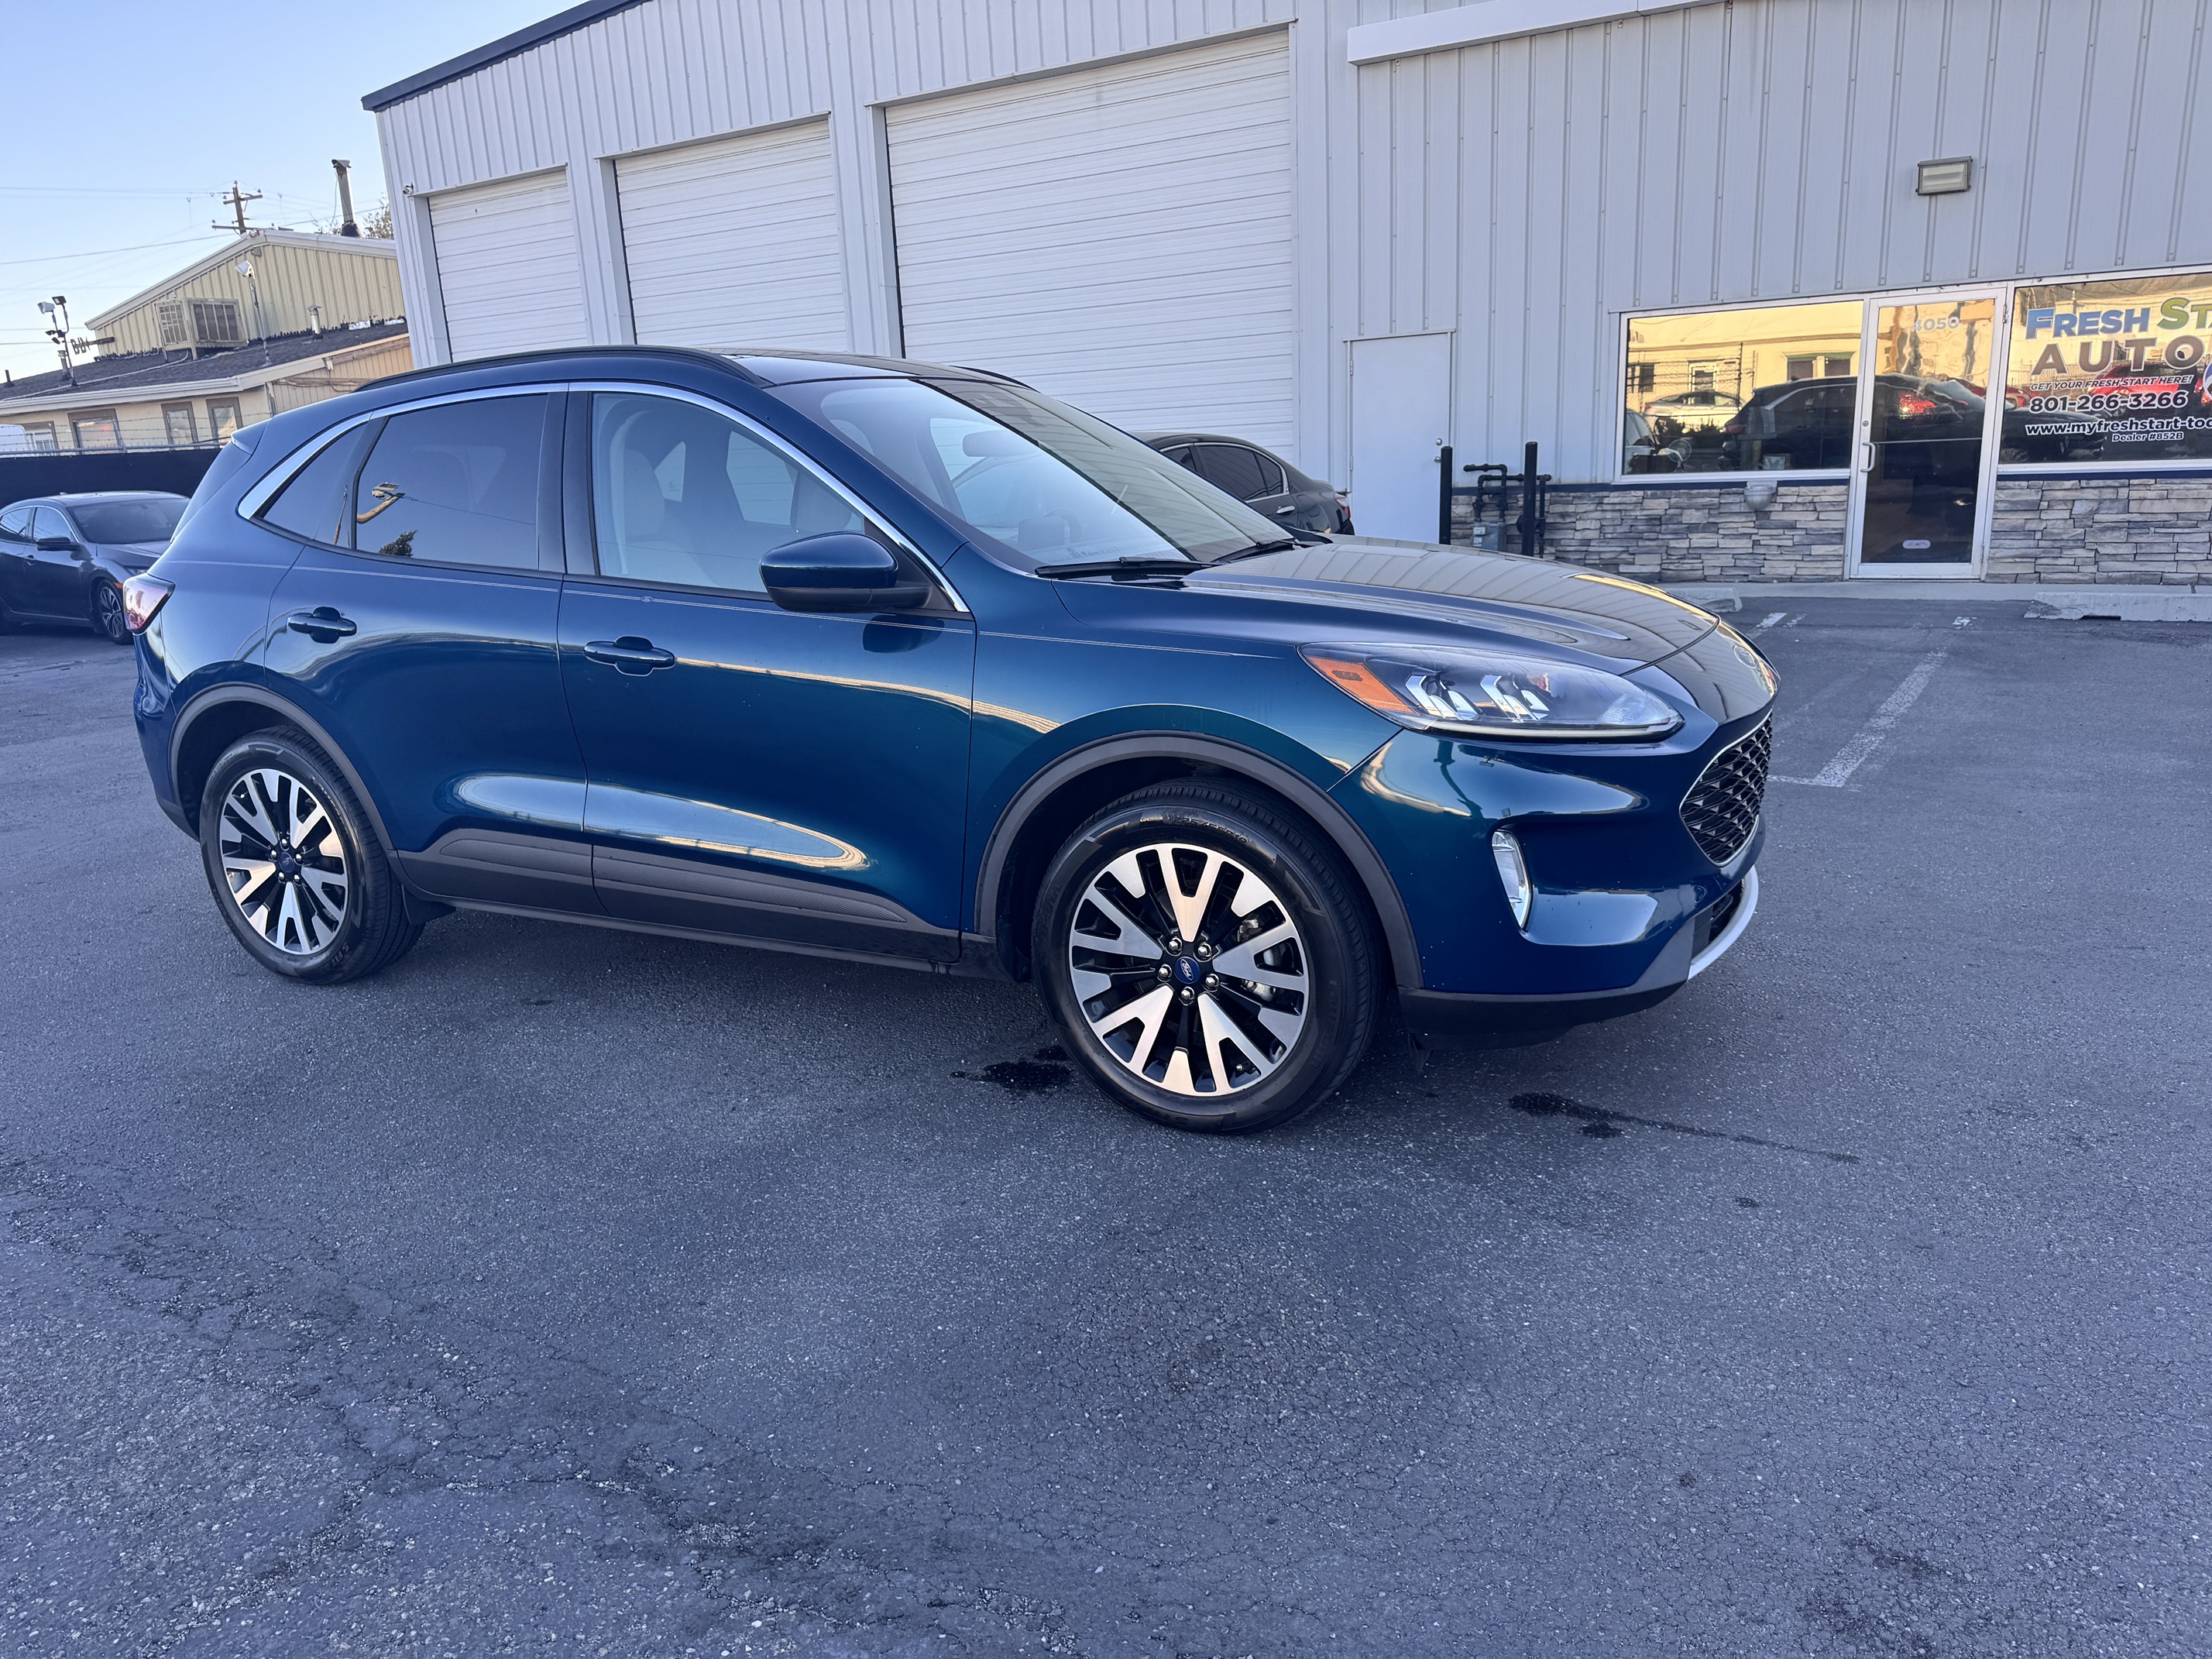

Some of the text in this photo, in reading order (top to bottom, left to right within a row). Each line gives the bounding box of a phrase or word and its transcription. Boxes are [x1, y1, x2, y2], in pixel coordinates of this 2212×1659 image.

[1911, 316, 1960, 331] 4050
[2025, 297, 2212, 340] FRESH ST
[2031, 335, 2205, 376] AUTO
[2030, 375, 2194, 391] GET YOUR FRESH START HERE!
[2029, 390, 2189, 414] 801-266-3266
[2112, 431, 2184, 442] Dealer #852B
